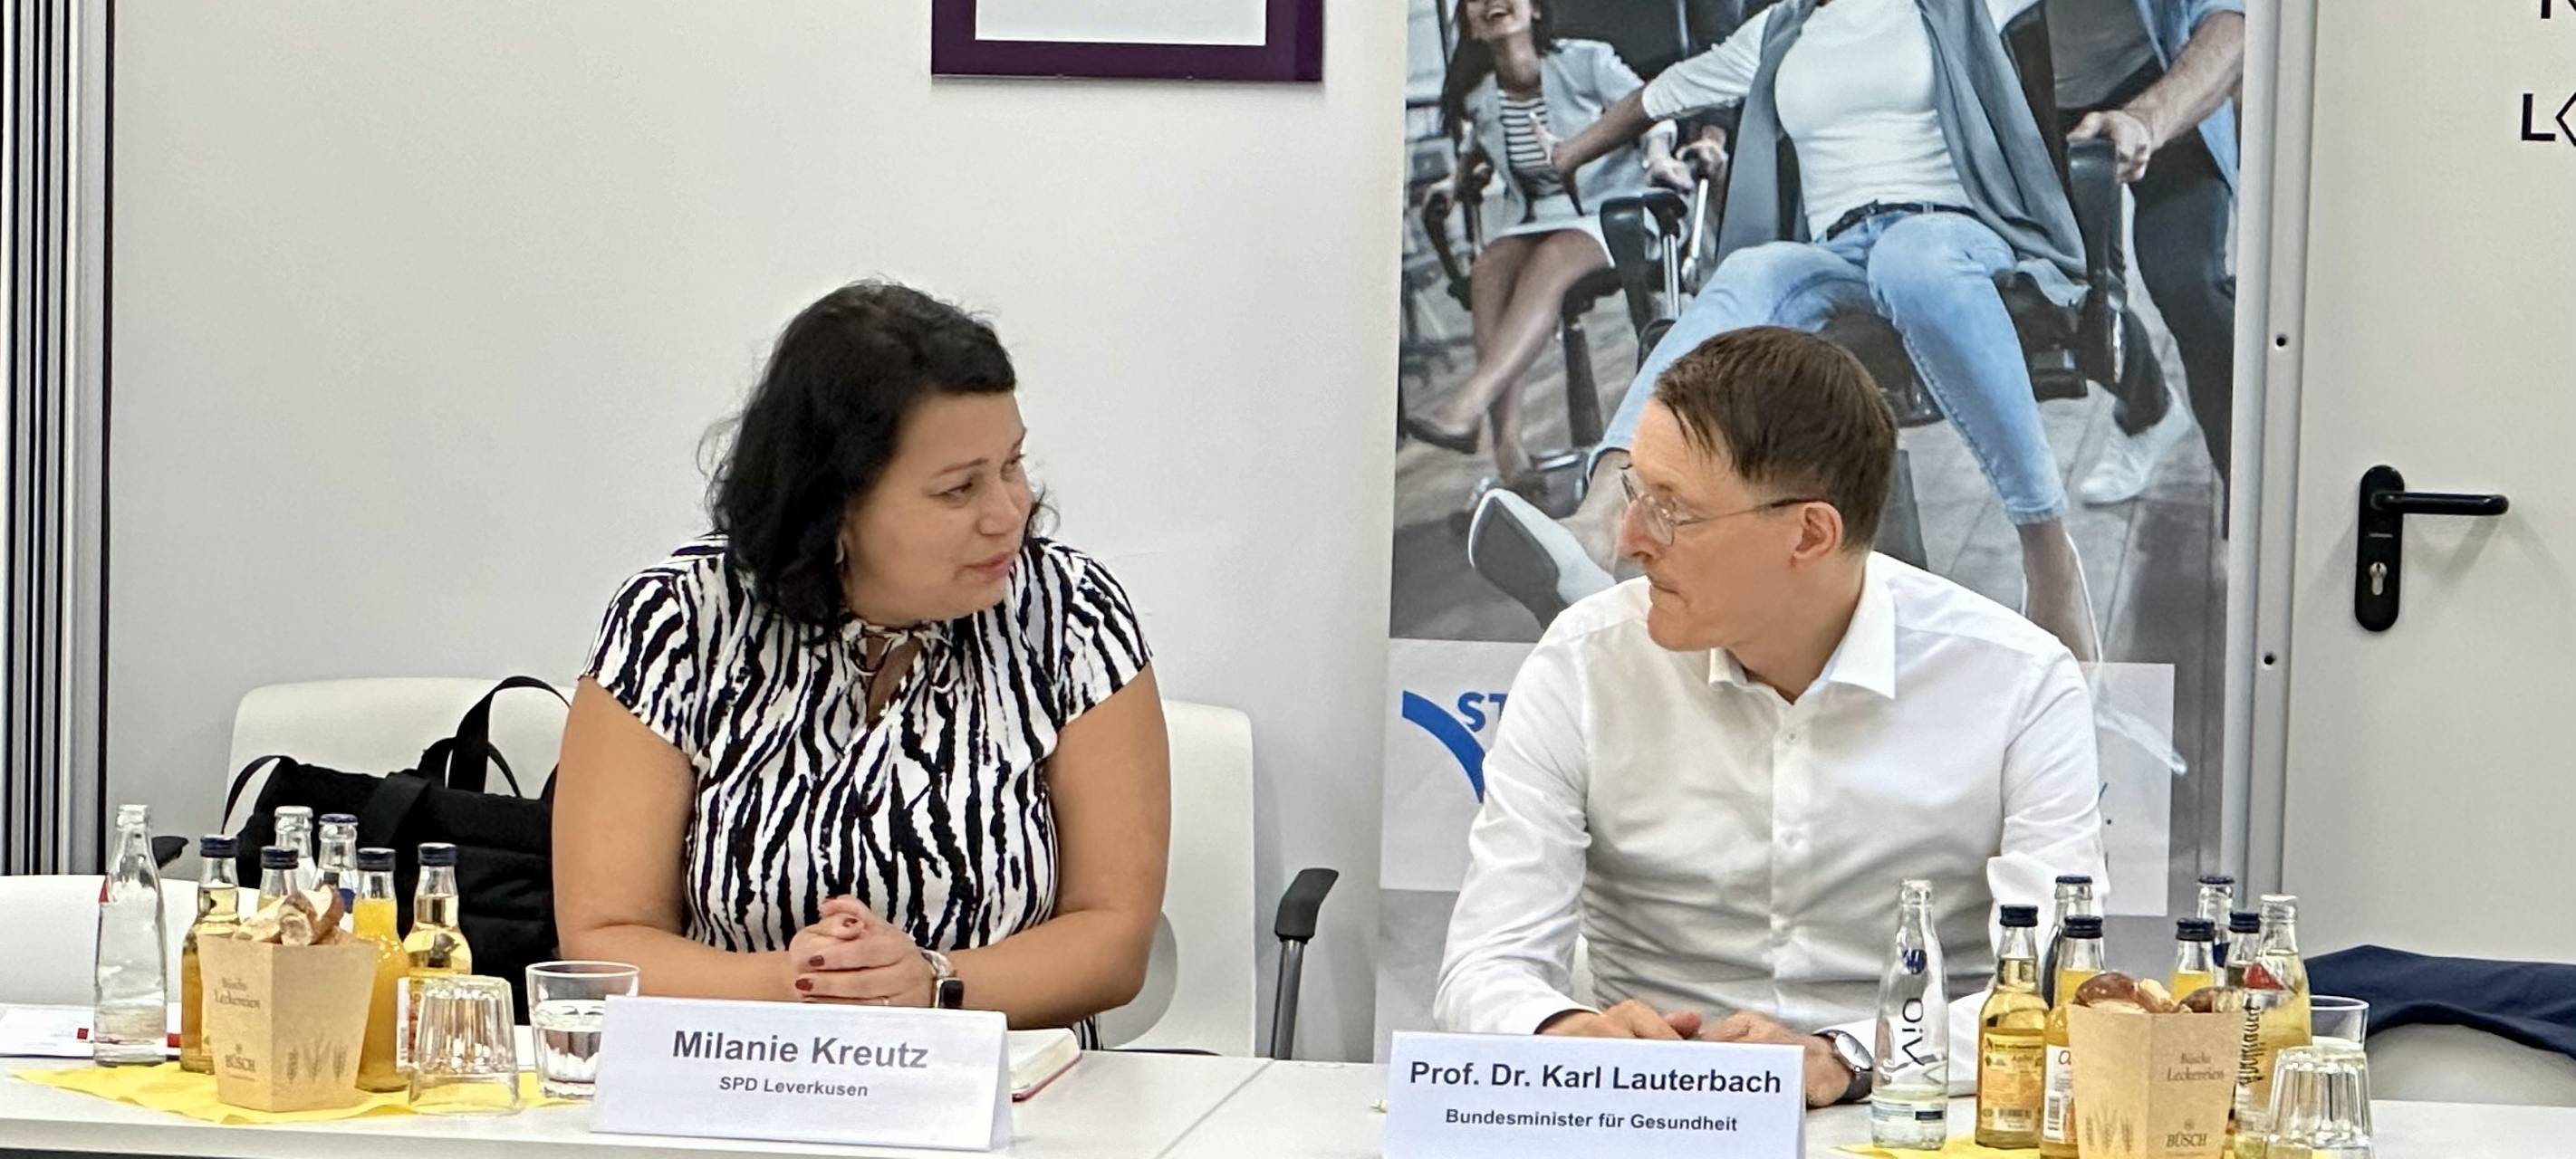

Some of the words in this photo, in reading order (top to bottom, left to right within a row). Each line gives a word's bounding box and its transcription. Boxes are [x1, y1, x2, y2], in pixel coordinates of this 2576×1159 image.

[673, 1030, 798, 1063] Milanie
[812, 1037, 928, 1069] Kreutz
[720, 1077, 758, 1092] SPD
[764, 1078, 868, 1097] Leverkusen
[1410, 1061, 1479, 1086] Prof.
[1491, 1063, 1531, 1087] Dr.
[1542, 1064, 1602, 1089] Karl
[1612, 1066, 1782, 1094] Lauterbach
[1446, 1108, 1594, 1127] Bundesminister
[1599, 1113, 1625, 1128] für
[1629, 1114, 1737, 1131] Gesundheit
